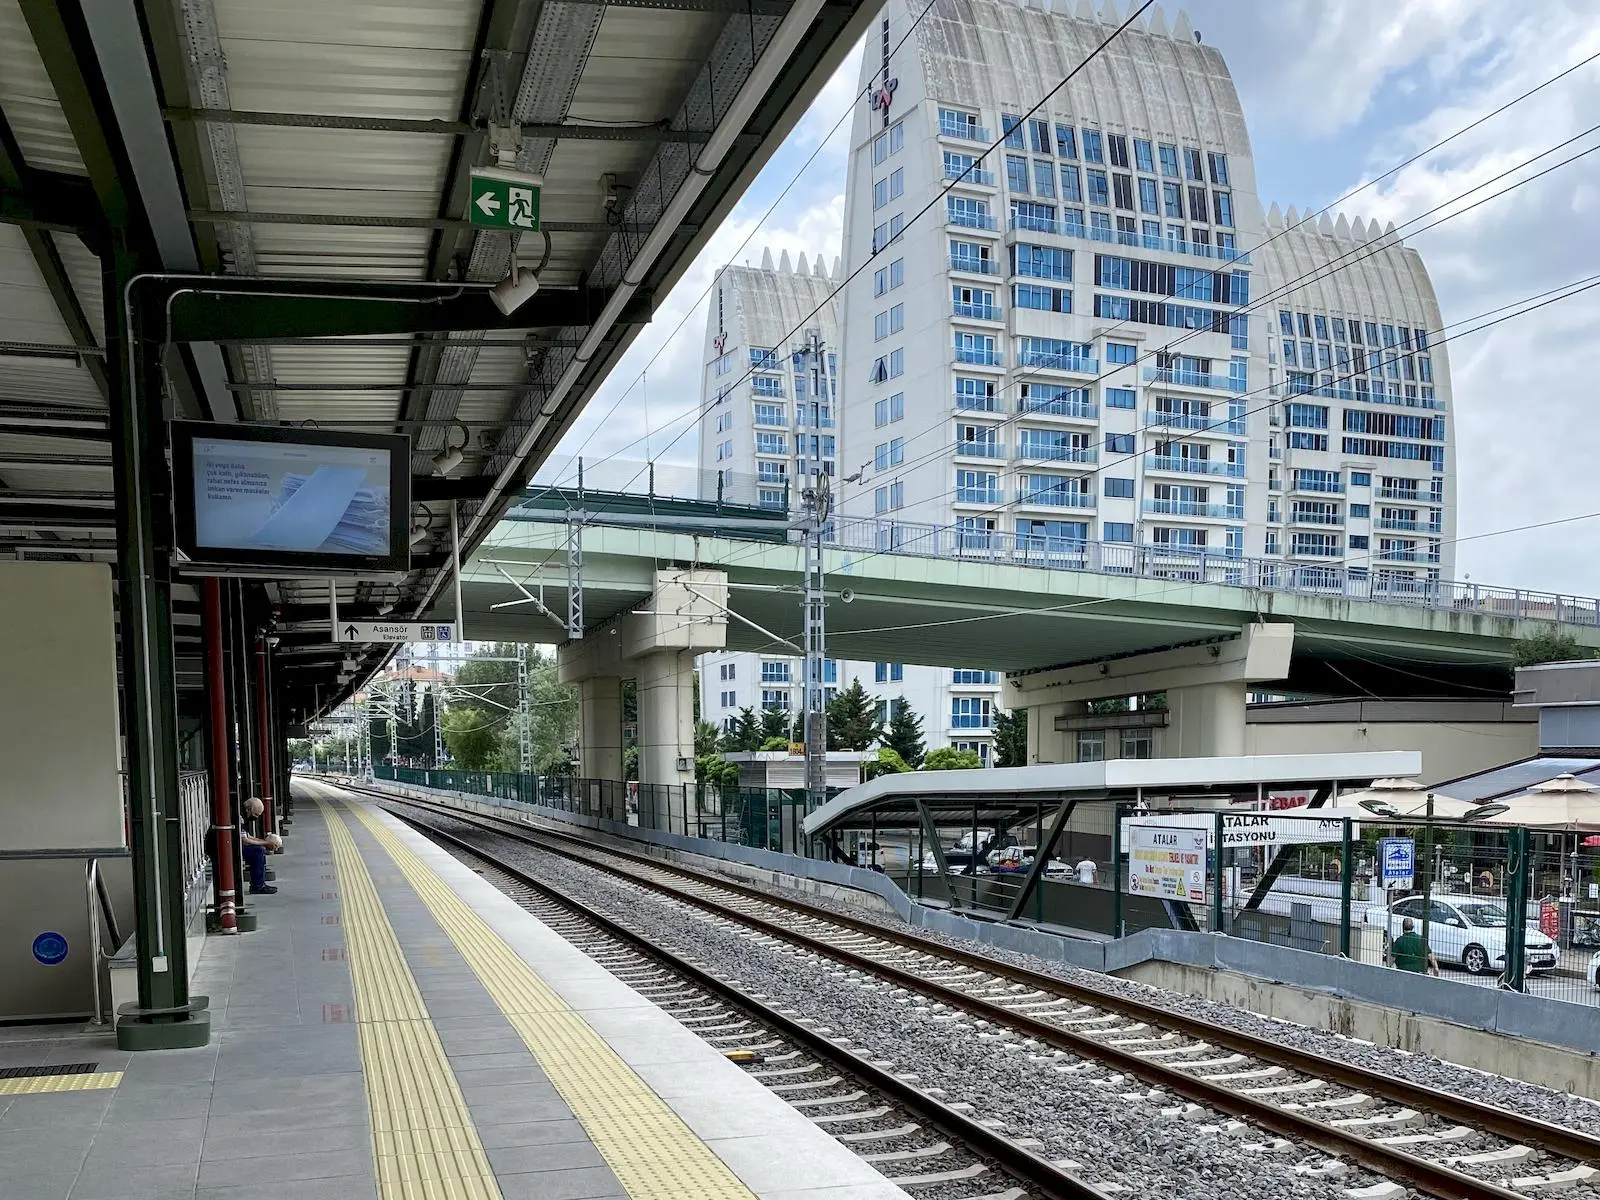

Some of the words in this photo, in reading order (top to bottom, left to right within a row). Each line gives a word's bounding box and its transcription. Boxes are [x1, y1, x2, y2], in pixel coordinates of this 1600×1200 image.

[372, 624, 408, 633] Asansör
[1223, 815, 1269, 828] TALAR
[1153, 834, 1178, 846] ATALAR
[1210, 831, 1276, 844] İTASYONU
